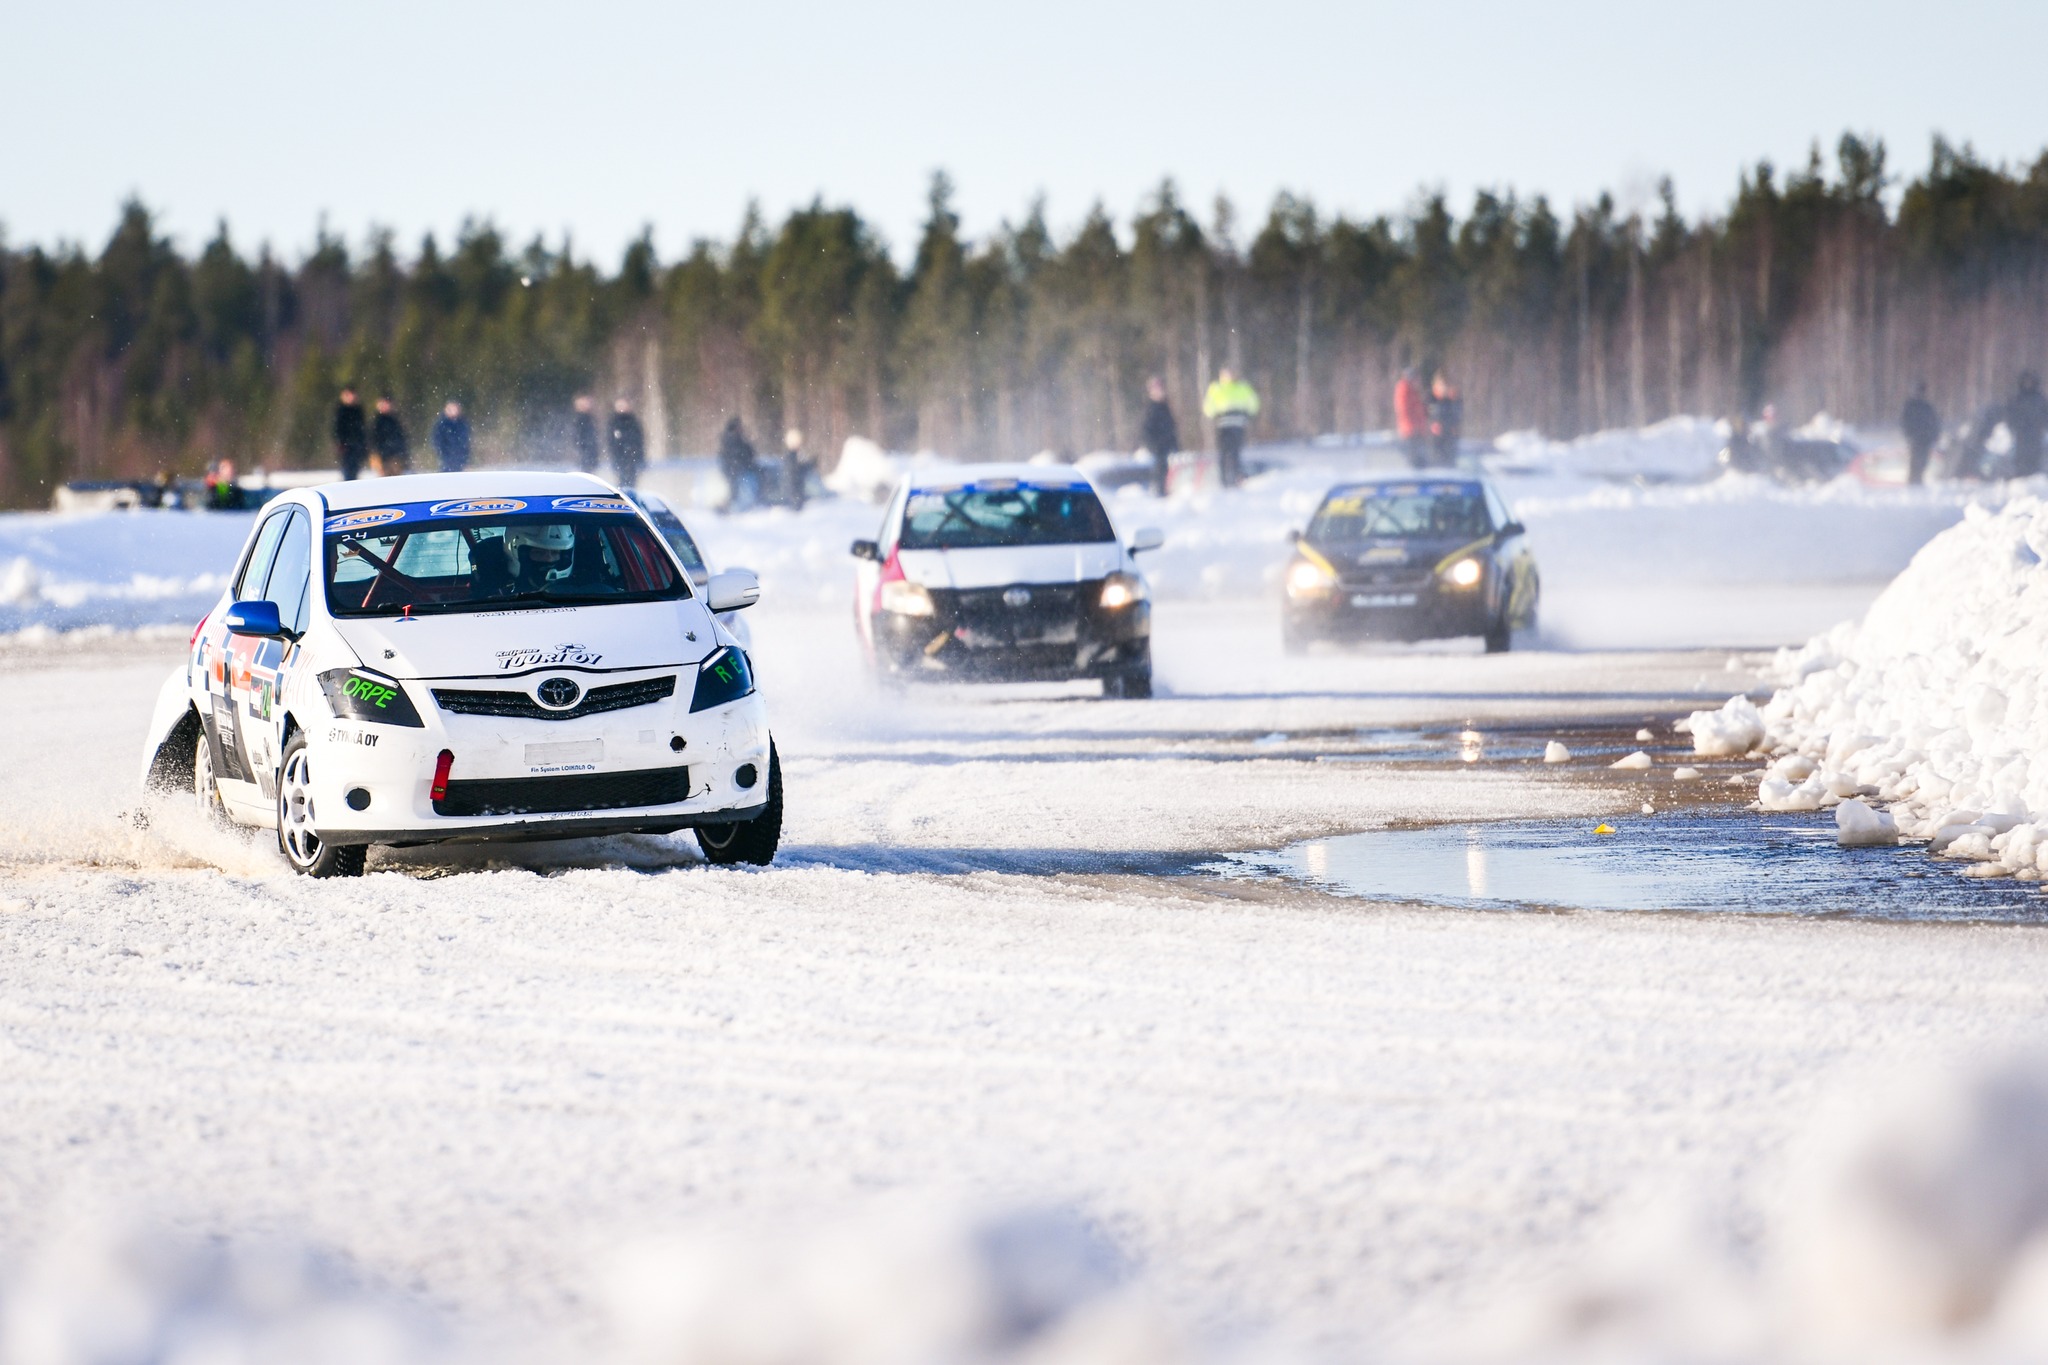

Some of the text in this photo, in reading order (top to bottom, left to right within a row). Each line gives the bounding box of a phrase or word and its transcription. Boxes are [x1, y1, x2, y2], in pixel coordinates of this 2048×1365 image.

[341, 531, 368, 543] 24
[498, 652, 603, 669] TUURI OY
[342, 677, 397, 709] ORPE
[364, 733, 380, 748] OY
